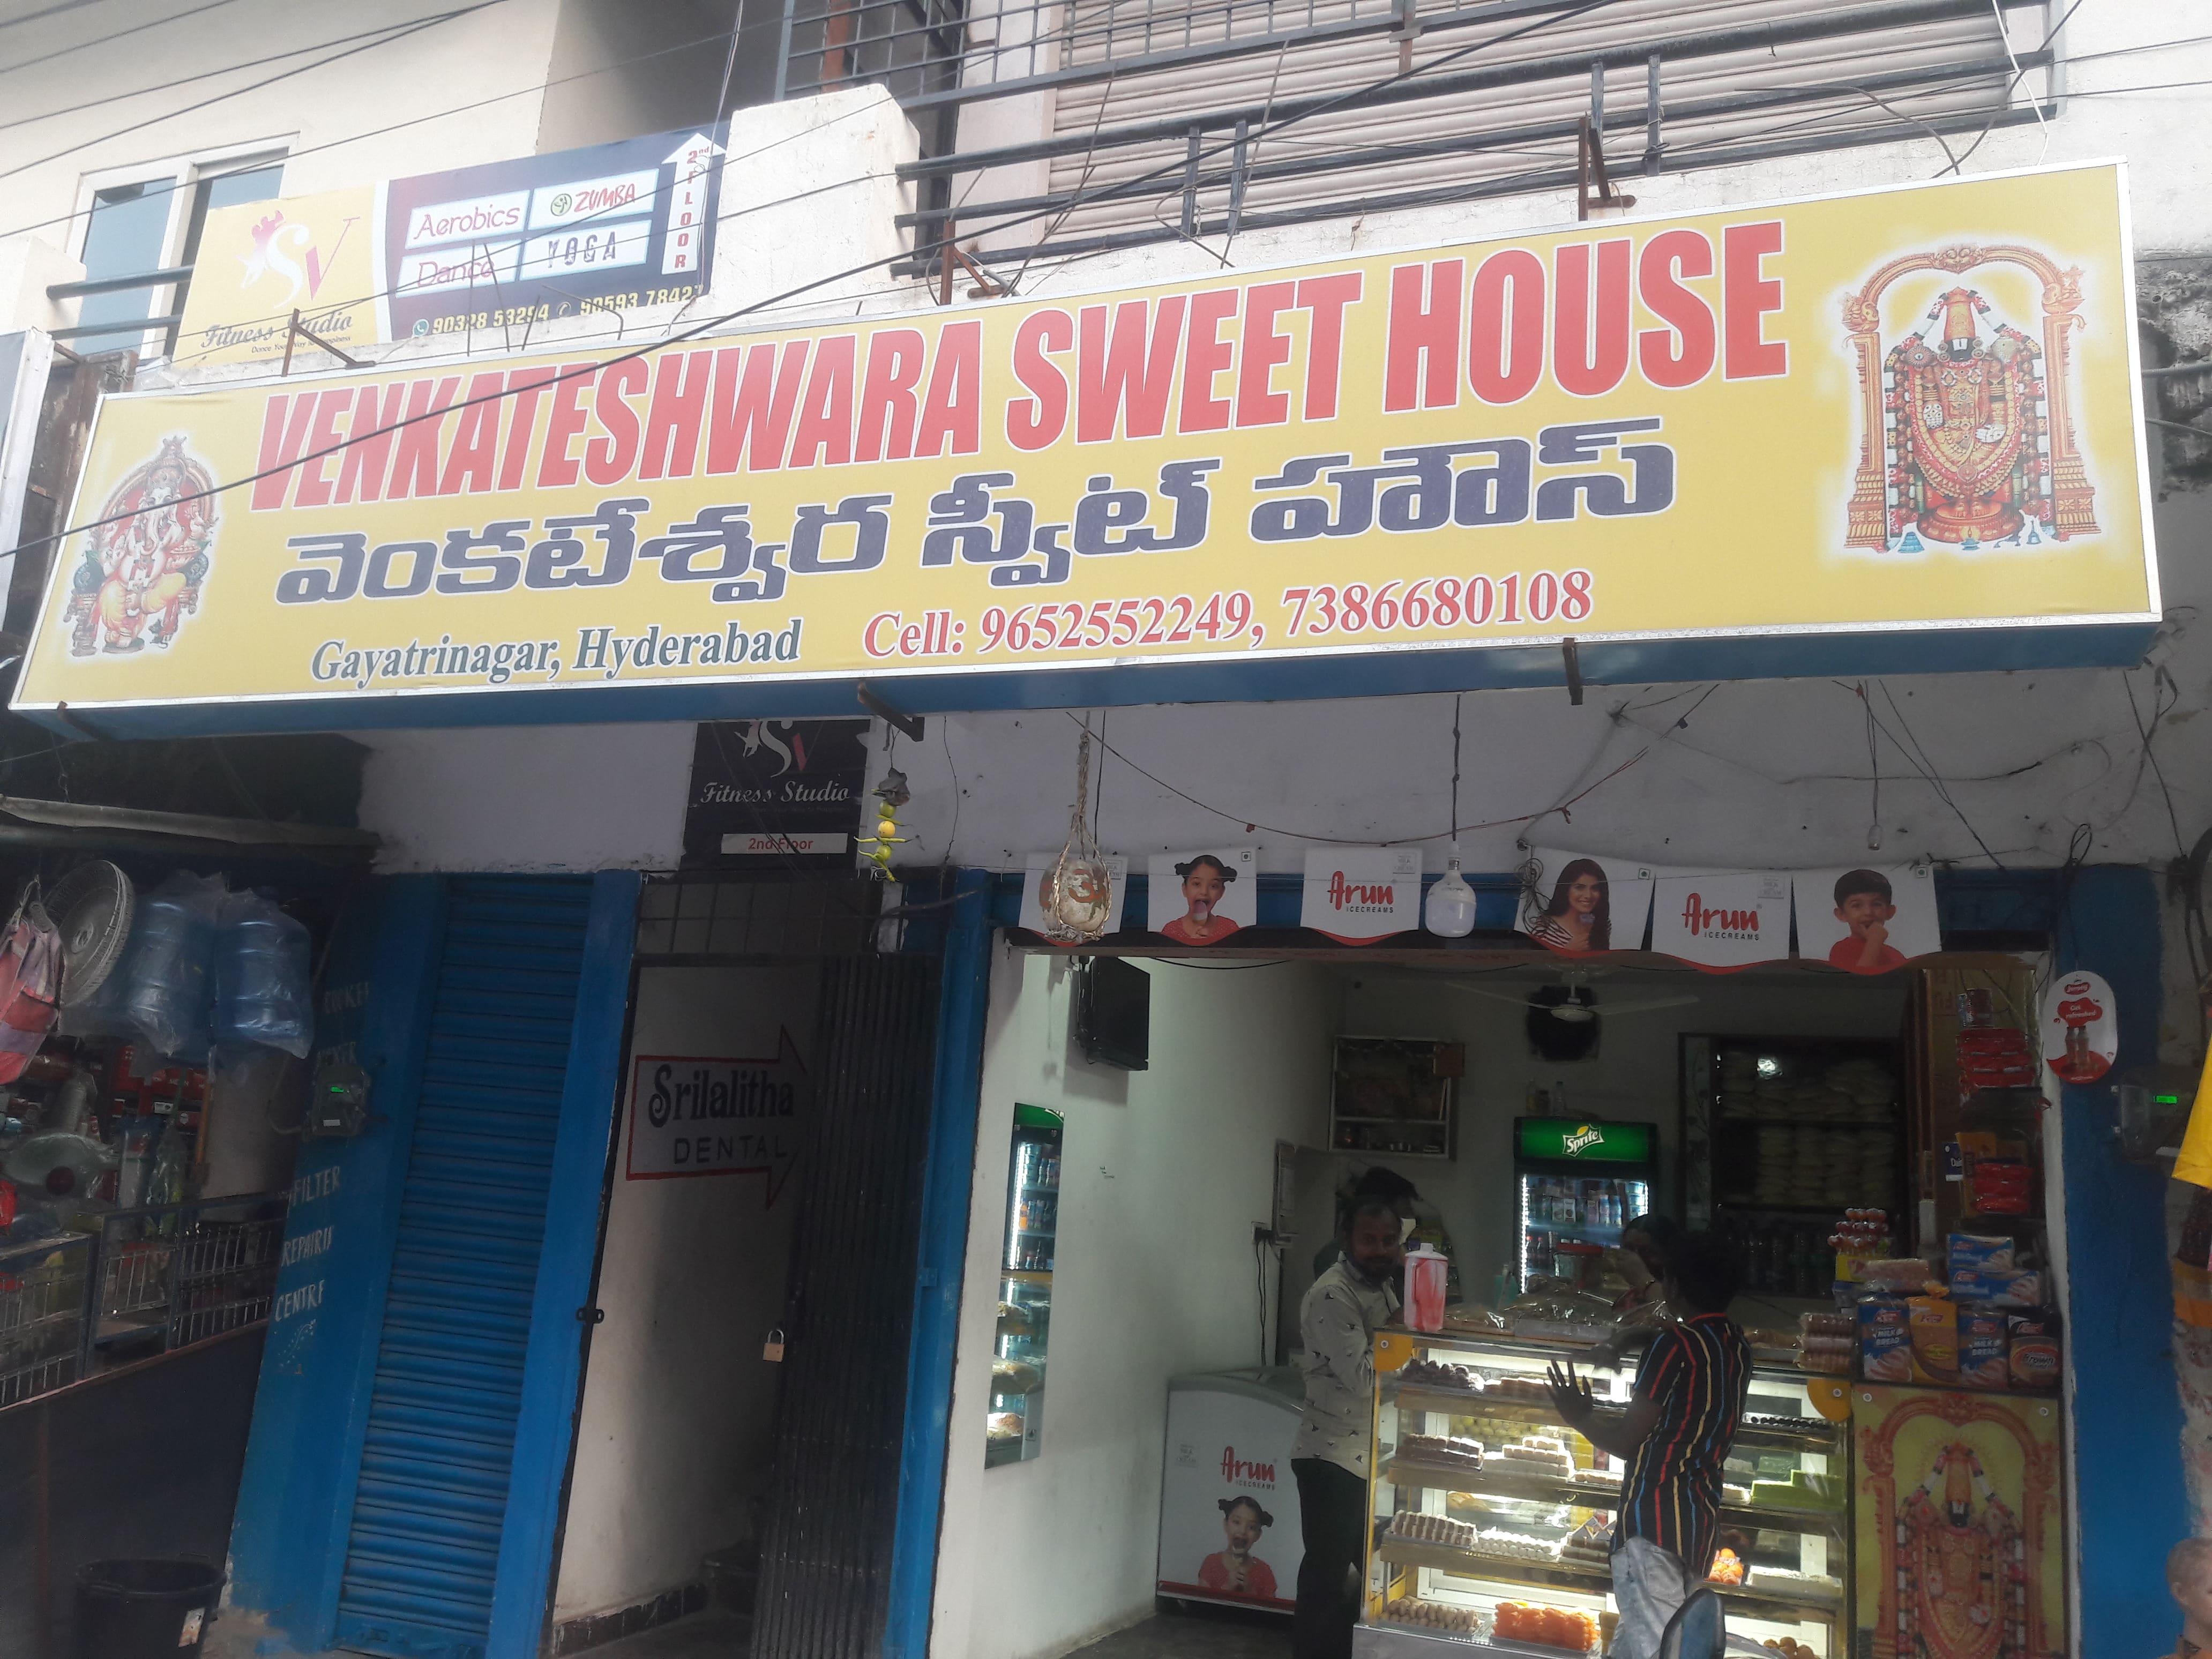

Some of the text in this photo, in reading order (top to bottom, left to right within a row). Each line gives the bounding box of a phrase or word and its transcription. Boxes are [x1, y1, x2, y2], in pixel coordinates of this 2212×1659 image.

[574, 183, 636, 212] ZUMBA
[413, 204, 520, 240] Aerobics
[548, 231, 616, 268] YOGA
[417, 260, 495, 287] Dance
[200, 324, 274, 348] Fitness
[250, 220, 1789, 511] VENKATESHWARA SWEET HOUSE
[275, 496, 893, 603] వెంకటేశ్వర
[921, 458, 1221, 587] స్వీట్
[863, 569, 1593, 663] Cell: 9652552249, 7386680108
[311, 617, 803, 690] Gayatrinagar, Hyderabad
[700, 780, 850, 804] Fitness Studio
[748, 837, 814, 850] 2nd Floor
[1327, 871, 1394, 910] Arun
[1346, 906, 1394, 914] ICECREAMS
[1681, 892, 1759, 936] Arun
[1704, 931, 1760, 941] ICECREAMS
[647, 1063, 795, 1129] Srilalitha
[674, 1134, 789, 1165] DENTAL
[1567, 1129, 1600, 1154] Sprite
[292, 1165, 340, 1207] FILTER
[1220, 1446, 1276, 1484] Arun
[1235, 1479, 1276, 1491] ICECREAMS
